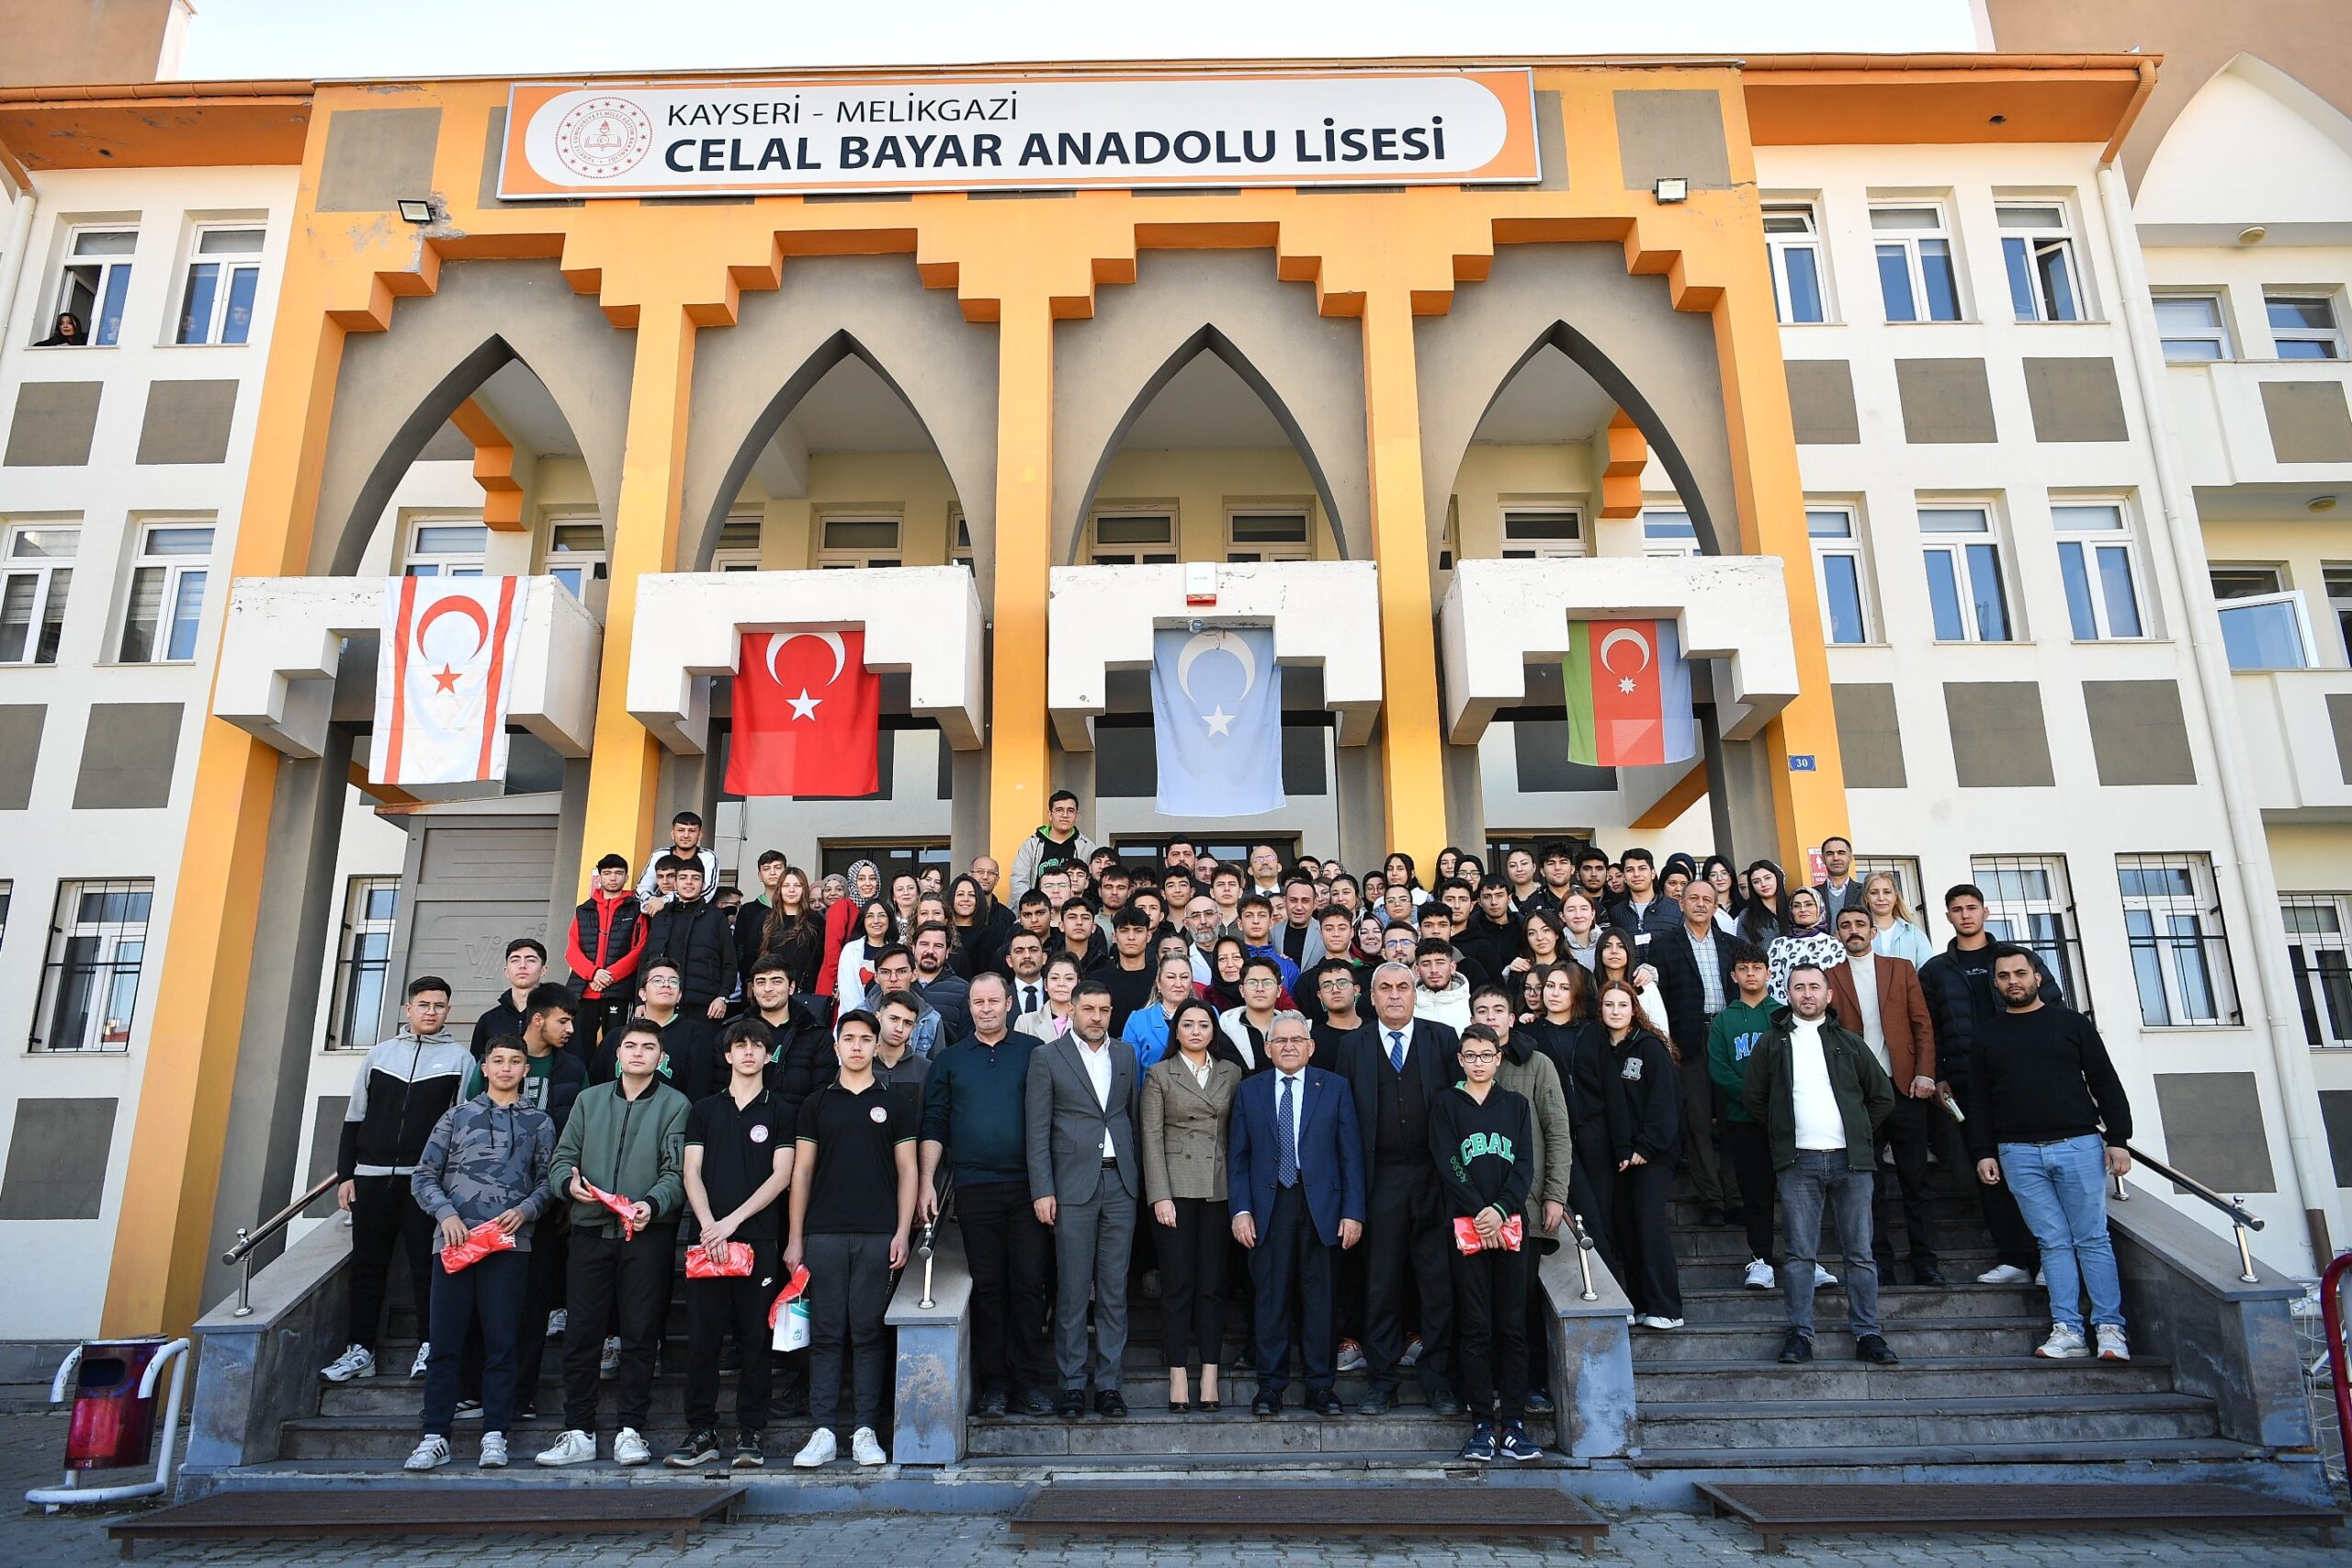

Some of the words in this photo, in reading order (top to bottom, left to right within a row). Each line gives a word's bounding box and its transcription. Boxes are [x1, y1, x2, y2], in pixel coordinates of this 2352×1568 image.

[668, 94, 799, 127] KAYSERİ
[836, 90, 1017, 123] MELİKGAZİ
[664, 137, 821, 173] CELAL
[839, 133, 1002, 170] BAYAR
[1018, 130, 1276, 166] ANADOLU
[1295, 115, 1445, 163] LİSESİ
[1795, 758, 1809, 768] 30
[1460, 1132, 1516, 1166] CBAL
